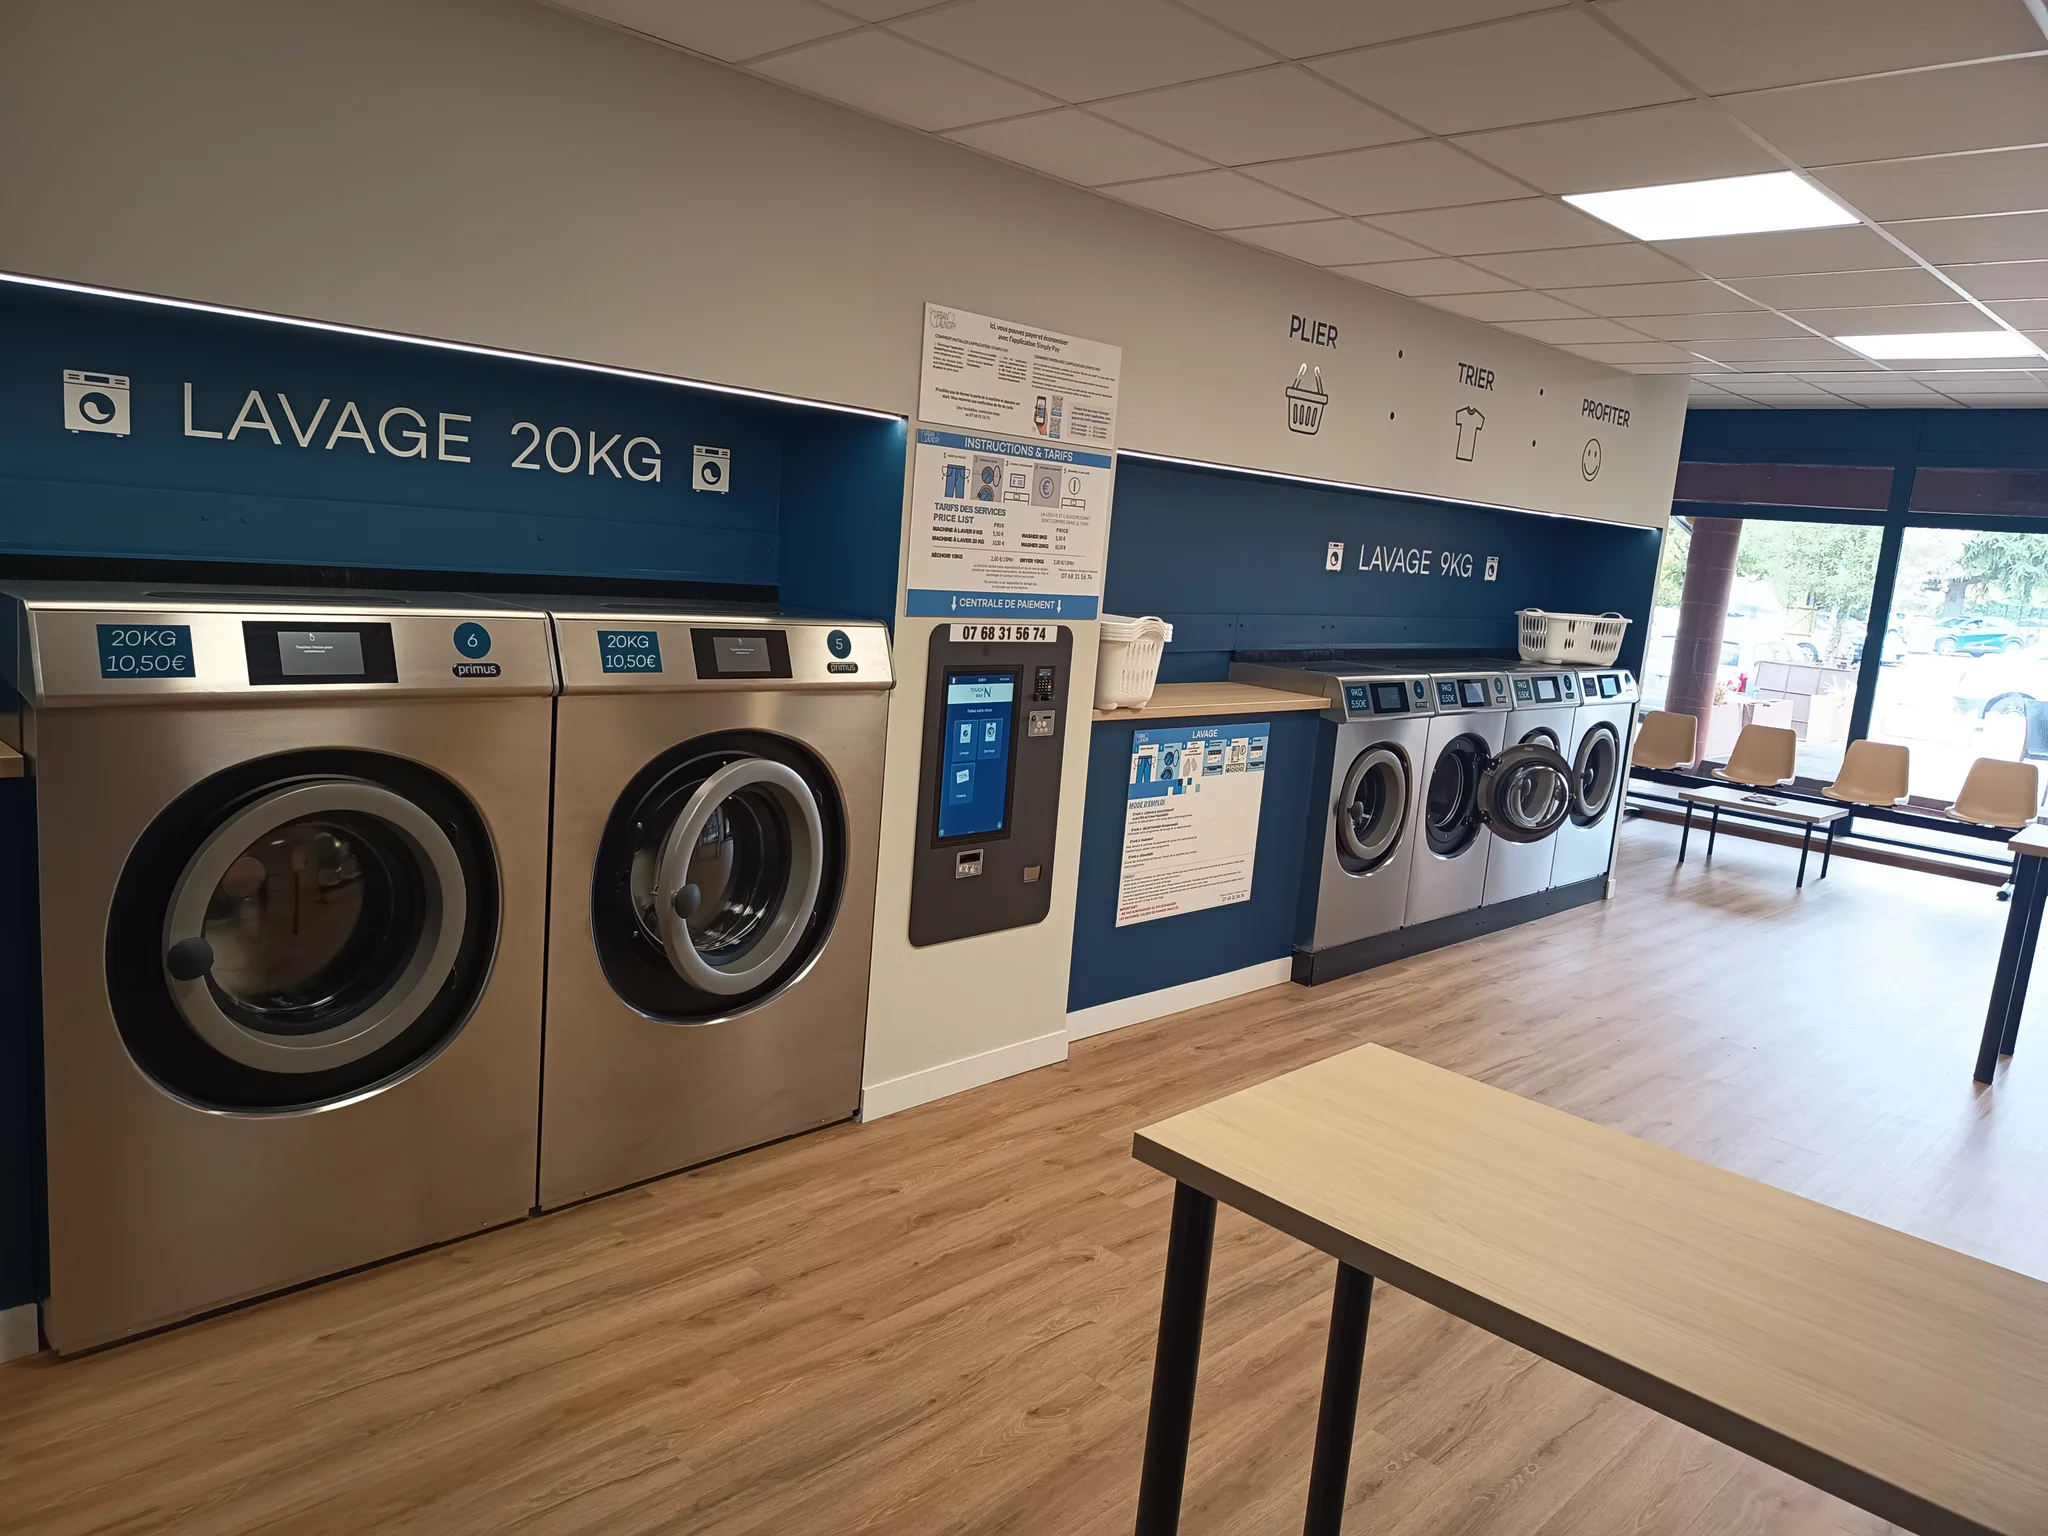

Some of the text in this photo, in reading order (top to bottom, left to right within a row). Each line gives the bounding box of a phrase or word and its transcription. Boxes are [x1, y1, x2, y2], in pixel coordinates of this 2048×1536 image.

[1008, 328, 1024, 336] pouvez
[1025, 331, 1038, 339] payer
[1043, 335, 1068, 345] économiser
[1290, 314, 1338, 349] PLIER
[1036, 342, 1051, 351] Simply
[1051, 345, 1060, 353] Pay
[1458, 362, 1495, 392] TRIER
[1582, 398, 1631, 428] PROFITER
[184, 382, 662, 482] LAVAGE 20KG
[965, 437, 1073, 462] INSTRUCTIONS & TARIFS
[935, 503, 1006, 516] TARIFS DES SERVICES
[933, 513, 974, 524] PRICE LIST
[1359, 544, 1473, 578] LAVAGE 9KG
[959, 598, 1055, 609] CENTRALE DE PAIEMENT
[111, 630, 177, 647] 20KG
[963, 626, 1046, 640] 07 68 31 56 74
[467, 633, 478, 648] 6
[607, 635, 649, 649] 20KG
[836, 638, 843, 650] 5
[106, 654, 186, 674] 10,50€
[605, 654, 655, 669] 10,50€
[830, 662, 856, 672] primus
[458, 663, 497, 677] primus
[984, 687, 992, 698] N
[1351, 688, 1363, 697] 9KG
[1441, 684, 1451, 692] 9KG
[1351, 699, 1366, 709] 5,50€
[1192, 729, 1218, 739] LAVAGE
[1129, 799, 1165, 809] MODE D'EMPLOI
